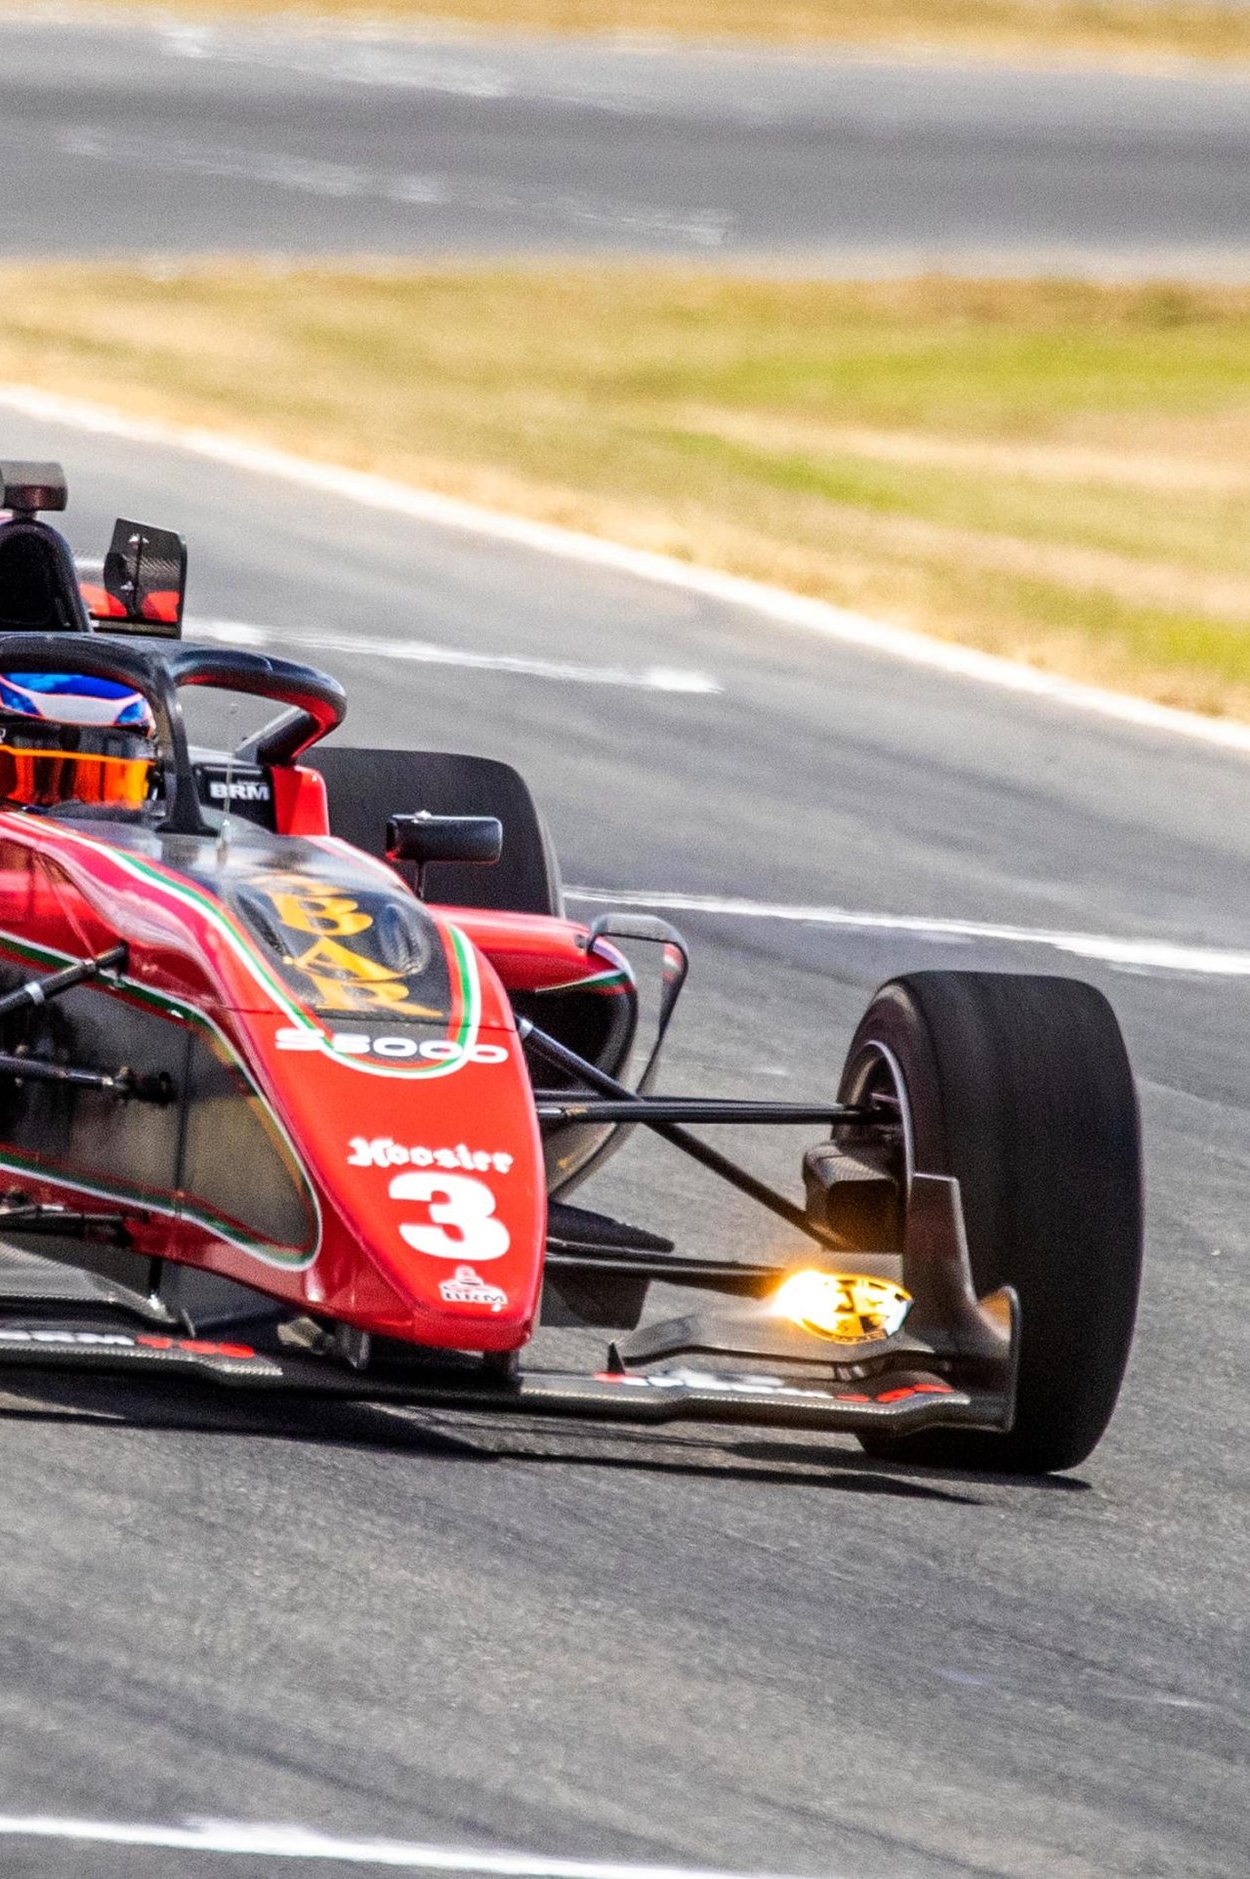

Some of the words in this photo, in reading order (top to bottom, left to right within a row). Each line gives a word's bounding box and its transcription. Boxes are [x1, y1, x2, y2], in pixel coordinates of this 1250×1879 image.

[210, 781, 270, 801] BRM
[275, 1027, 508, 1064] S5000
[388, 1171, 510, 1261] 3
